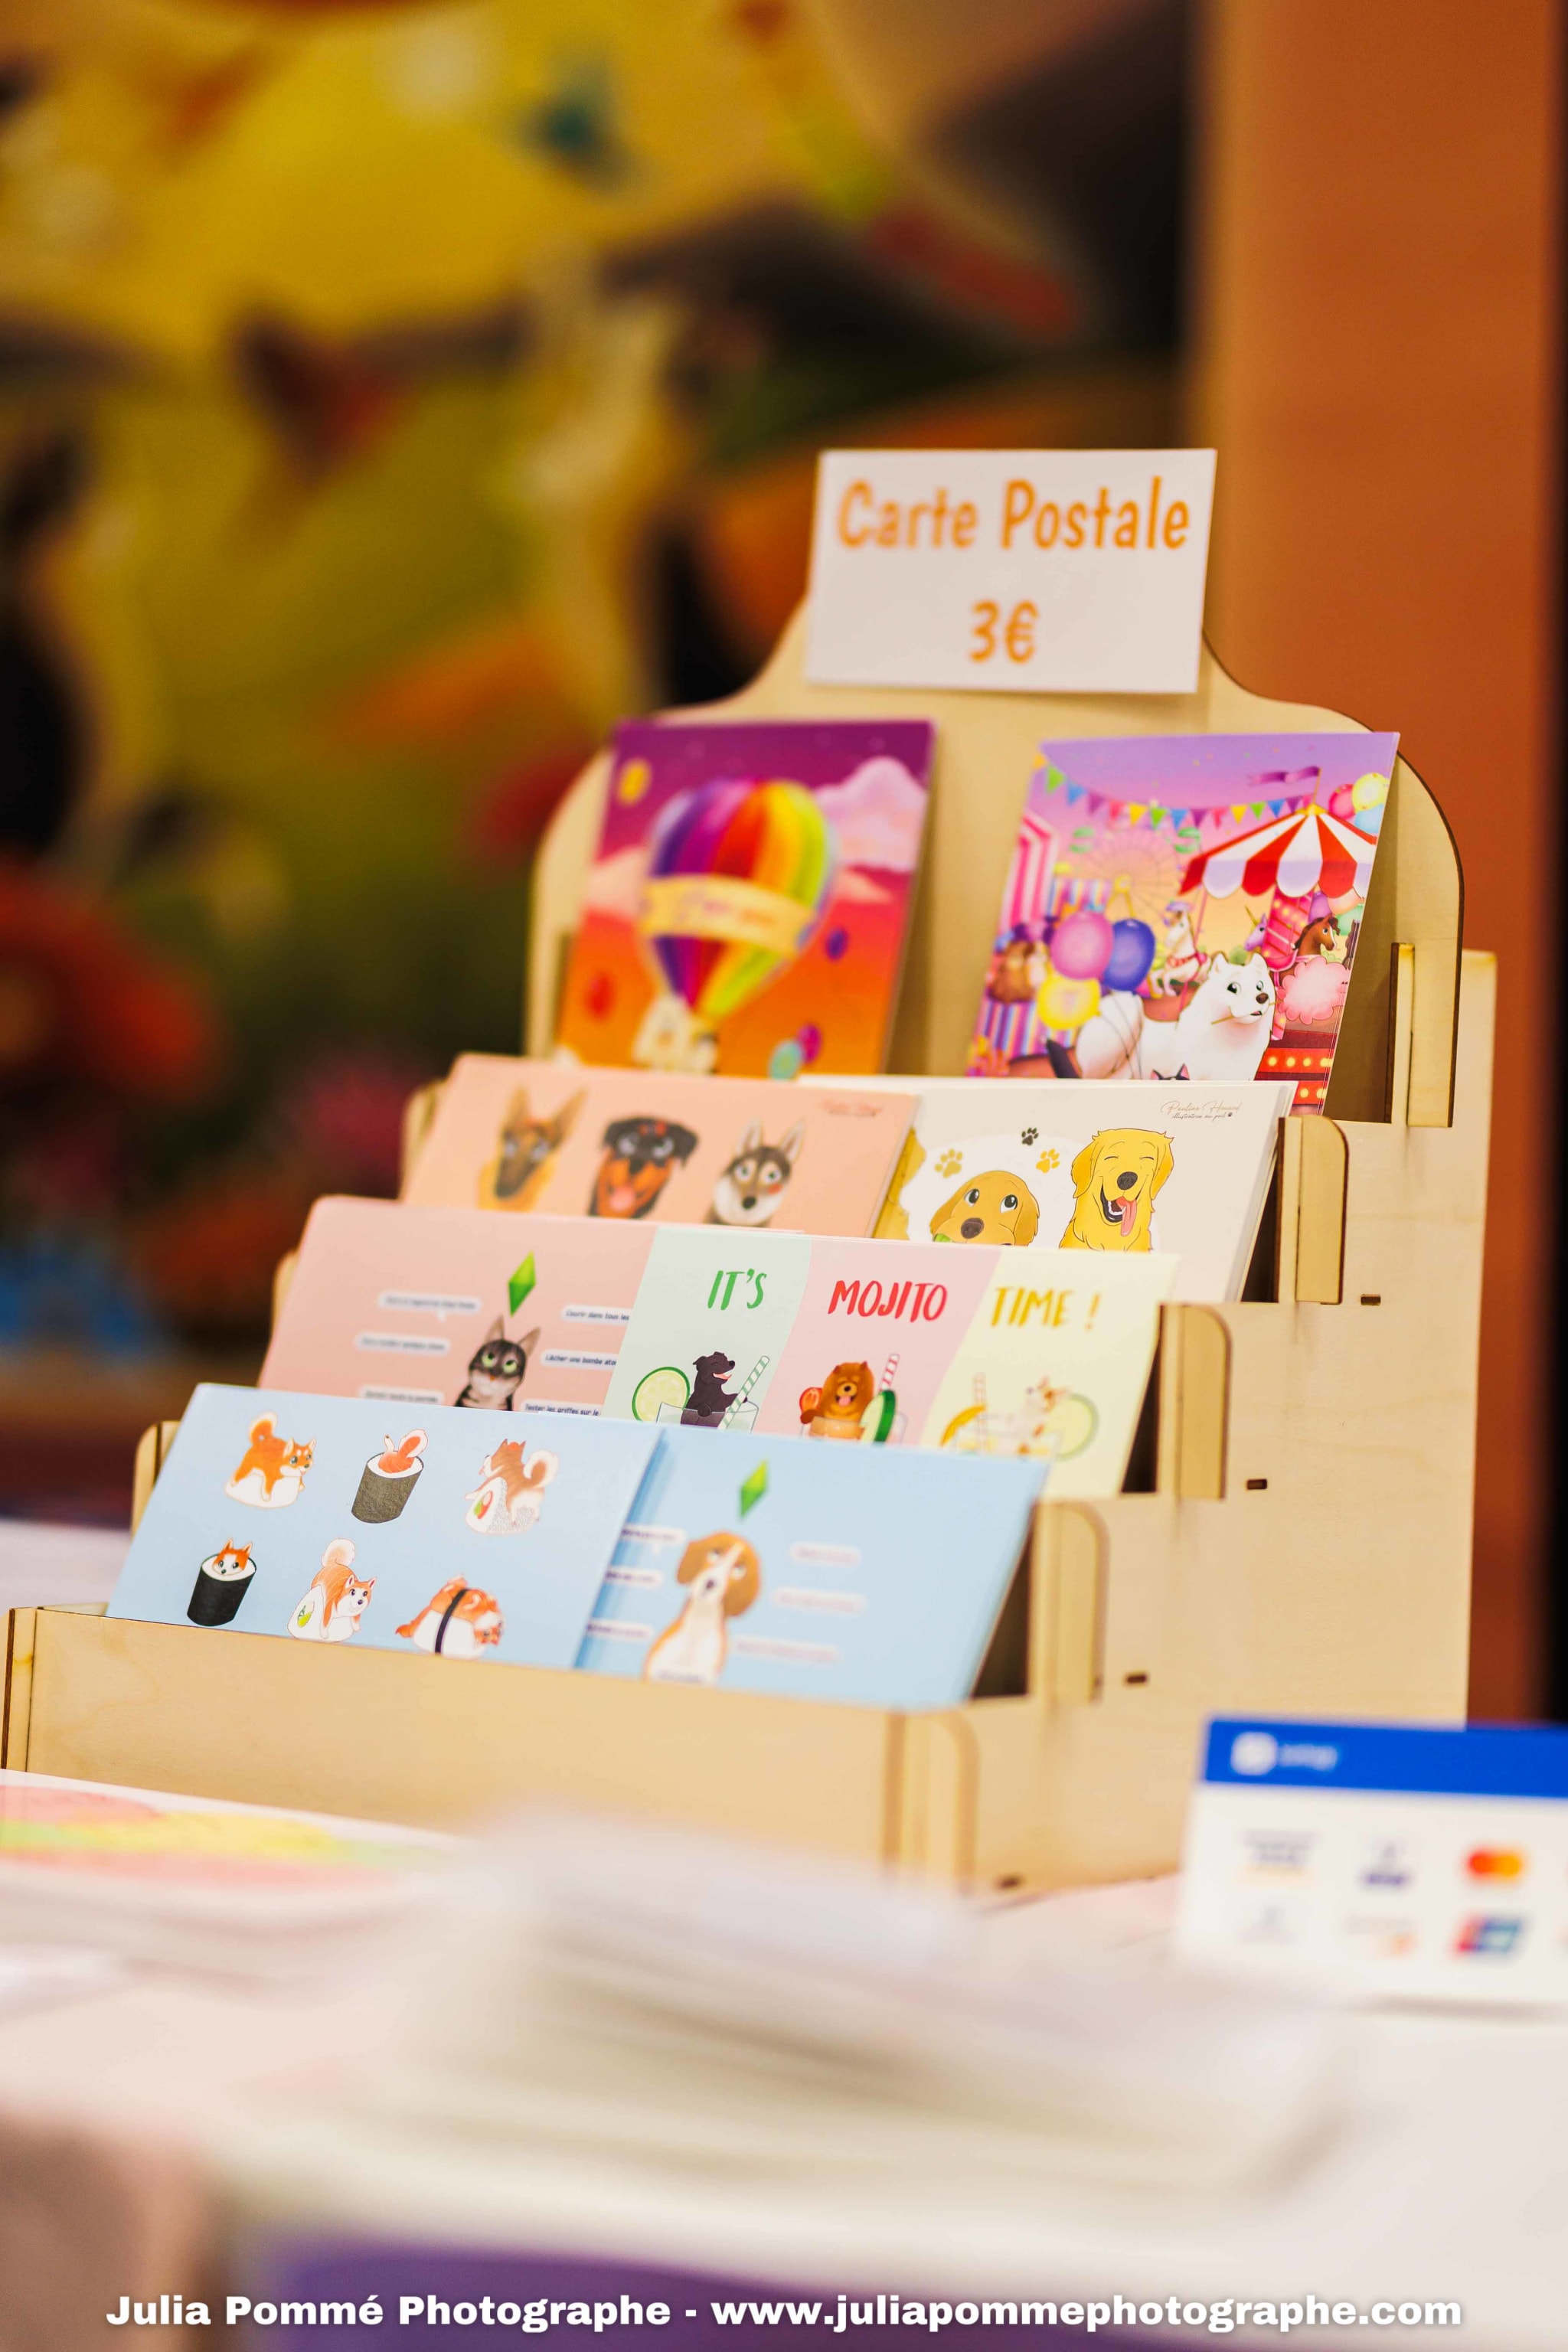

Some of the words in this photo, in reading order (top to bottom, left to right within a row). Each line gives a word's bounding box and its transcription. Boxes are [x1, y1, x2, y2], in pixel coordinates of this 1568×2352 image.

[837, 479, 978, 549] Carte
[999, 475, 1191, 550] Postale
[969, 600, 1039, 664] 3€
[605, 1312, 619, 1321] tous
[828, 1279, 948, 1323] MOJITO
[991, 1286, 1073, 1327] TIME
[1086, 1293, 1100, 1330] !
[582, 1357, 603, 1365] bombe
